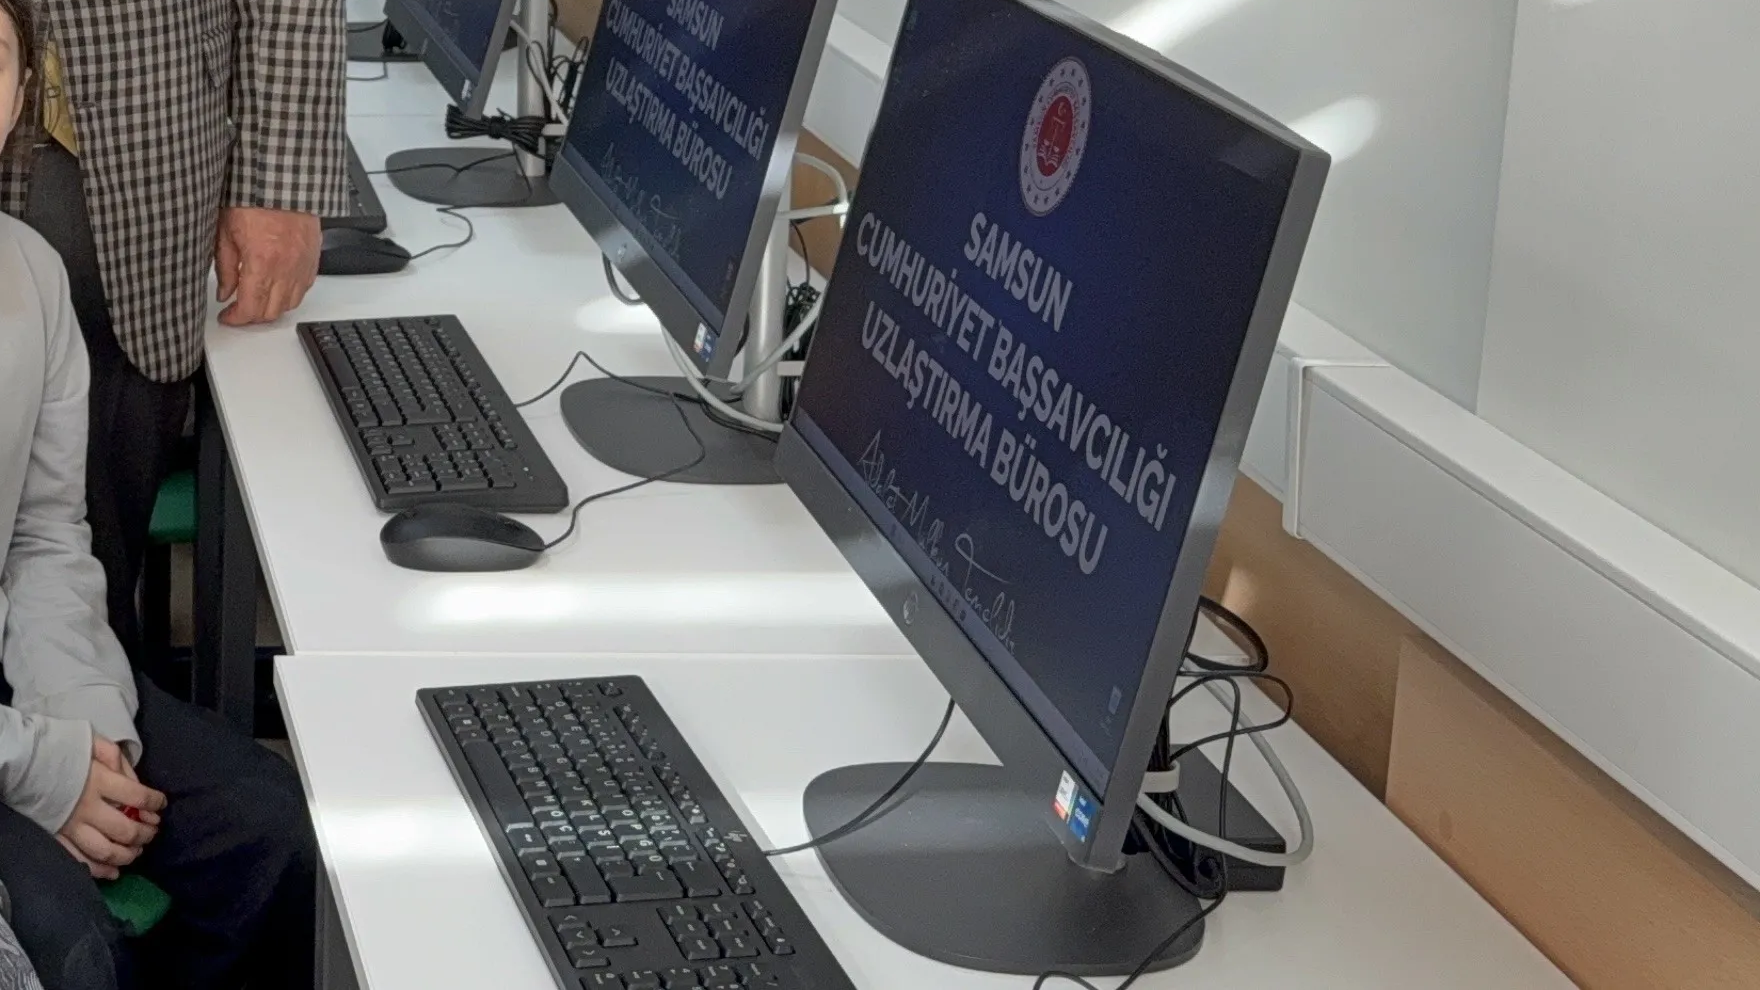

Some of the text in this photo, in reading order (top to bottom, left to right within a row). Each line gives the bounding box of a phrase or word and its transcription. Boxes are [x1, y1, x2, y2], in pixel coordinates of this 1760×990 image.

[604, 56, 678, 150] UZLAŞTIRMA
[672, 121, 734, 201] BÜROSU
[676, 56, 770, 162] BAŞSAVCILIĞI
[963, 211, 1073, 332] SAMSUN
[855, 211, 1177, 531] CUMHURİYET BAŞSAVCILIĞI
[861, 300, 1109, 575] UZLAŞTIRMA BÜROSU
